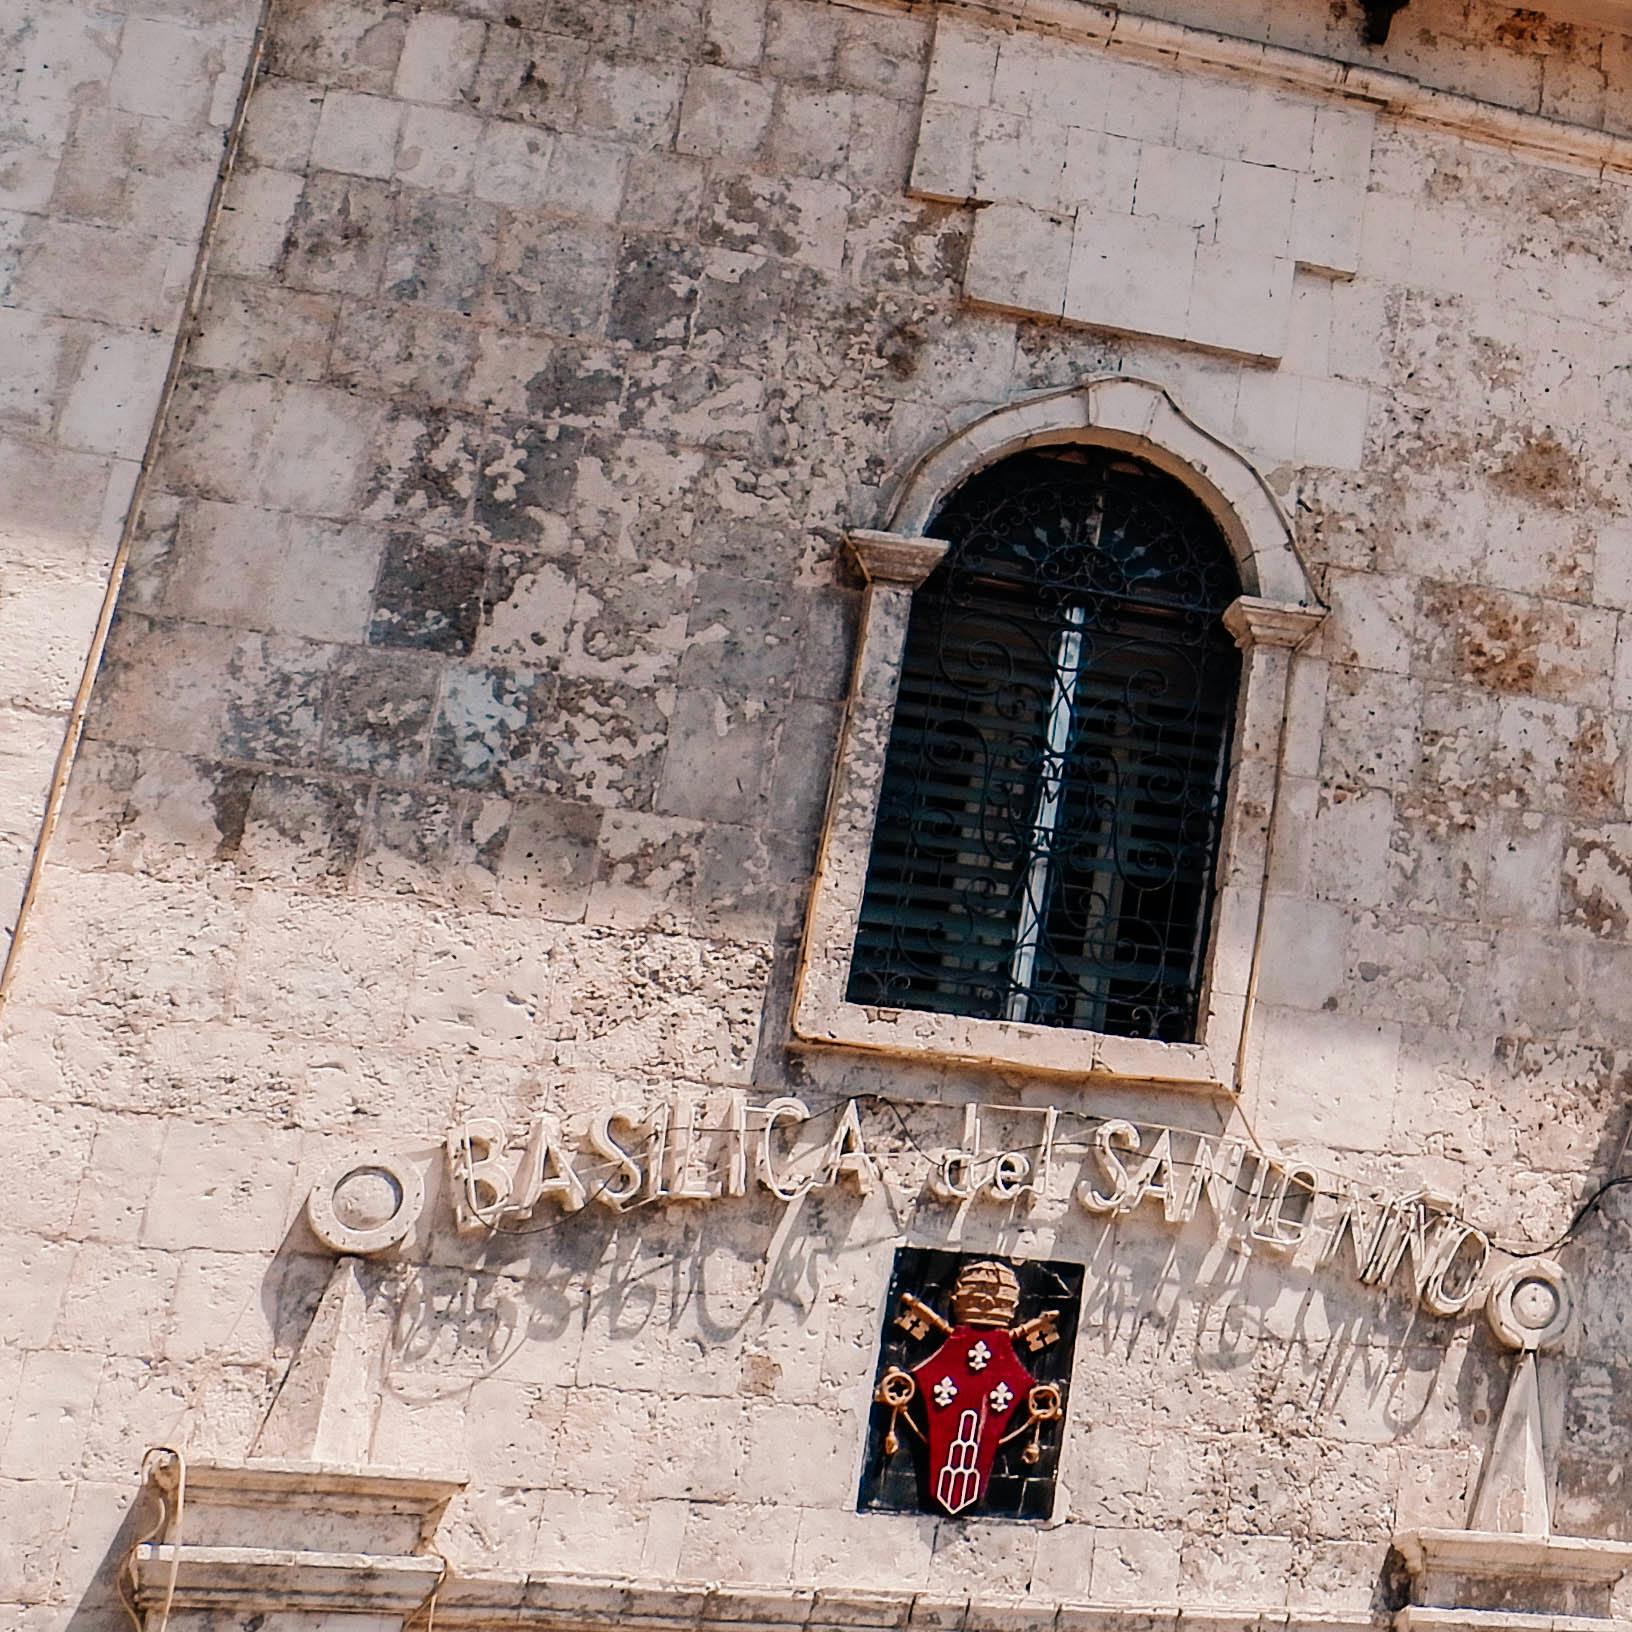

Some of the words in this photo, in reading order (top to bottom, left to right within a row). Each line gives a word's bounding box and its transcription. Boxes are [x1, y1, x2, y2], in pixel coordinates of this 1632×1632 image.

[447, 1097, 880, 1232] BASILICA
[928, 1102, 1059, 1200] del
[1077, 1118, 1318, 1250] SANTO
